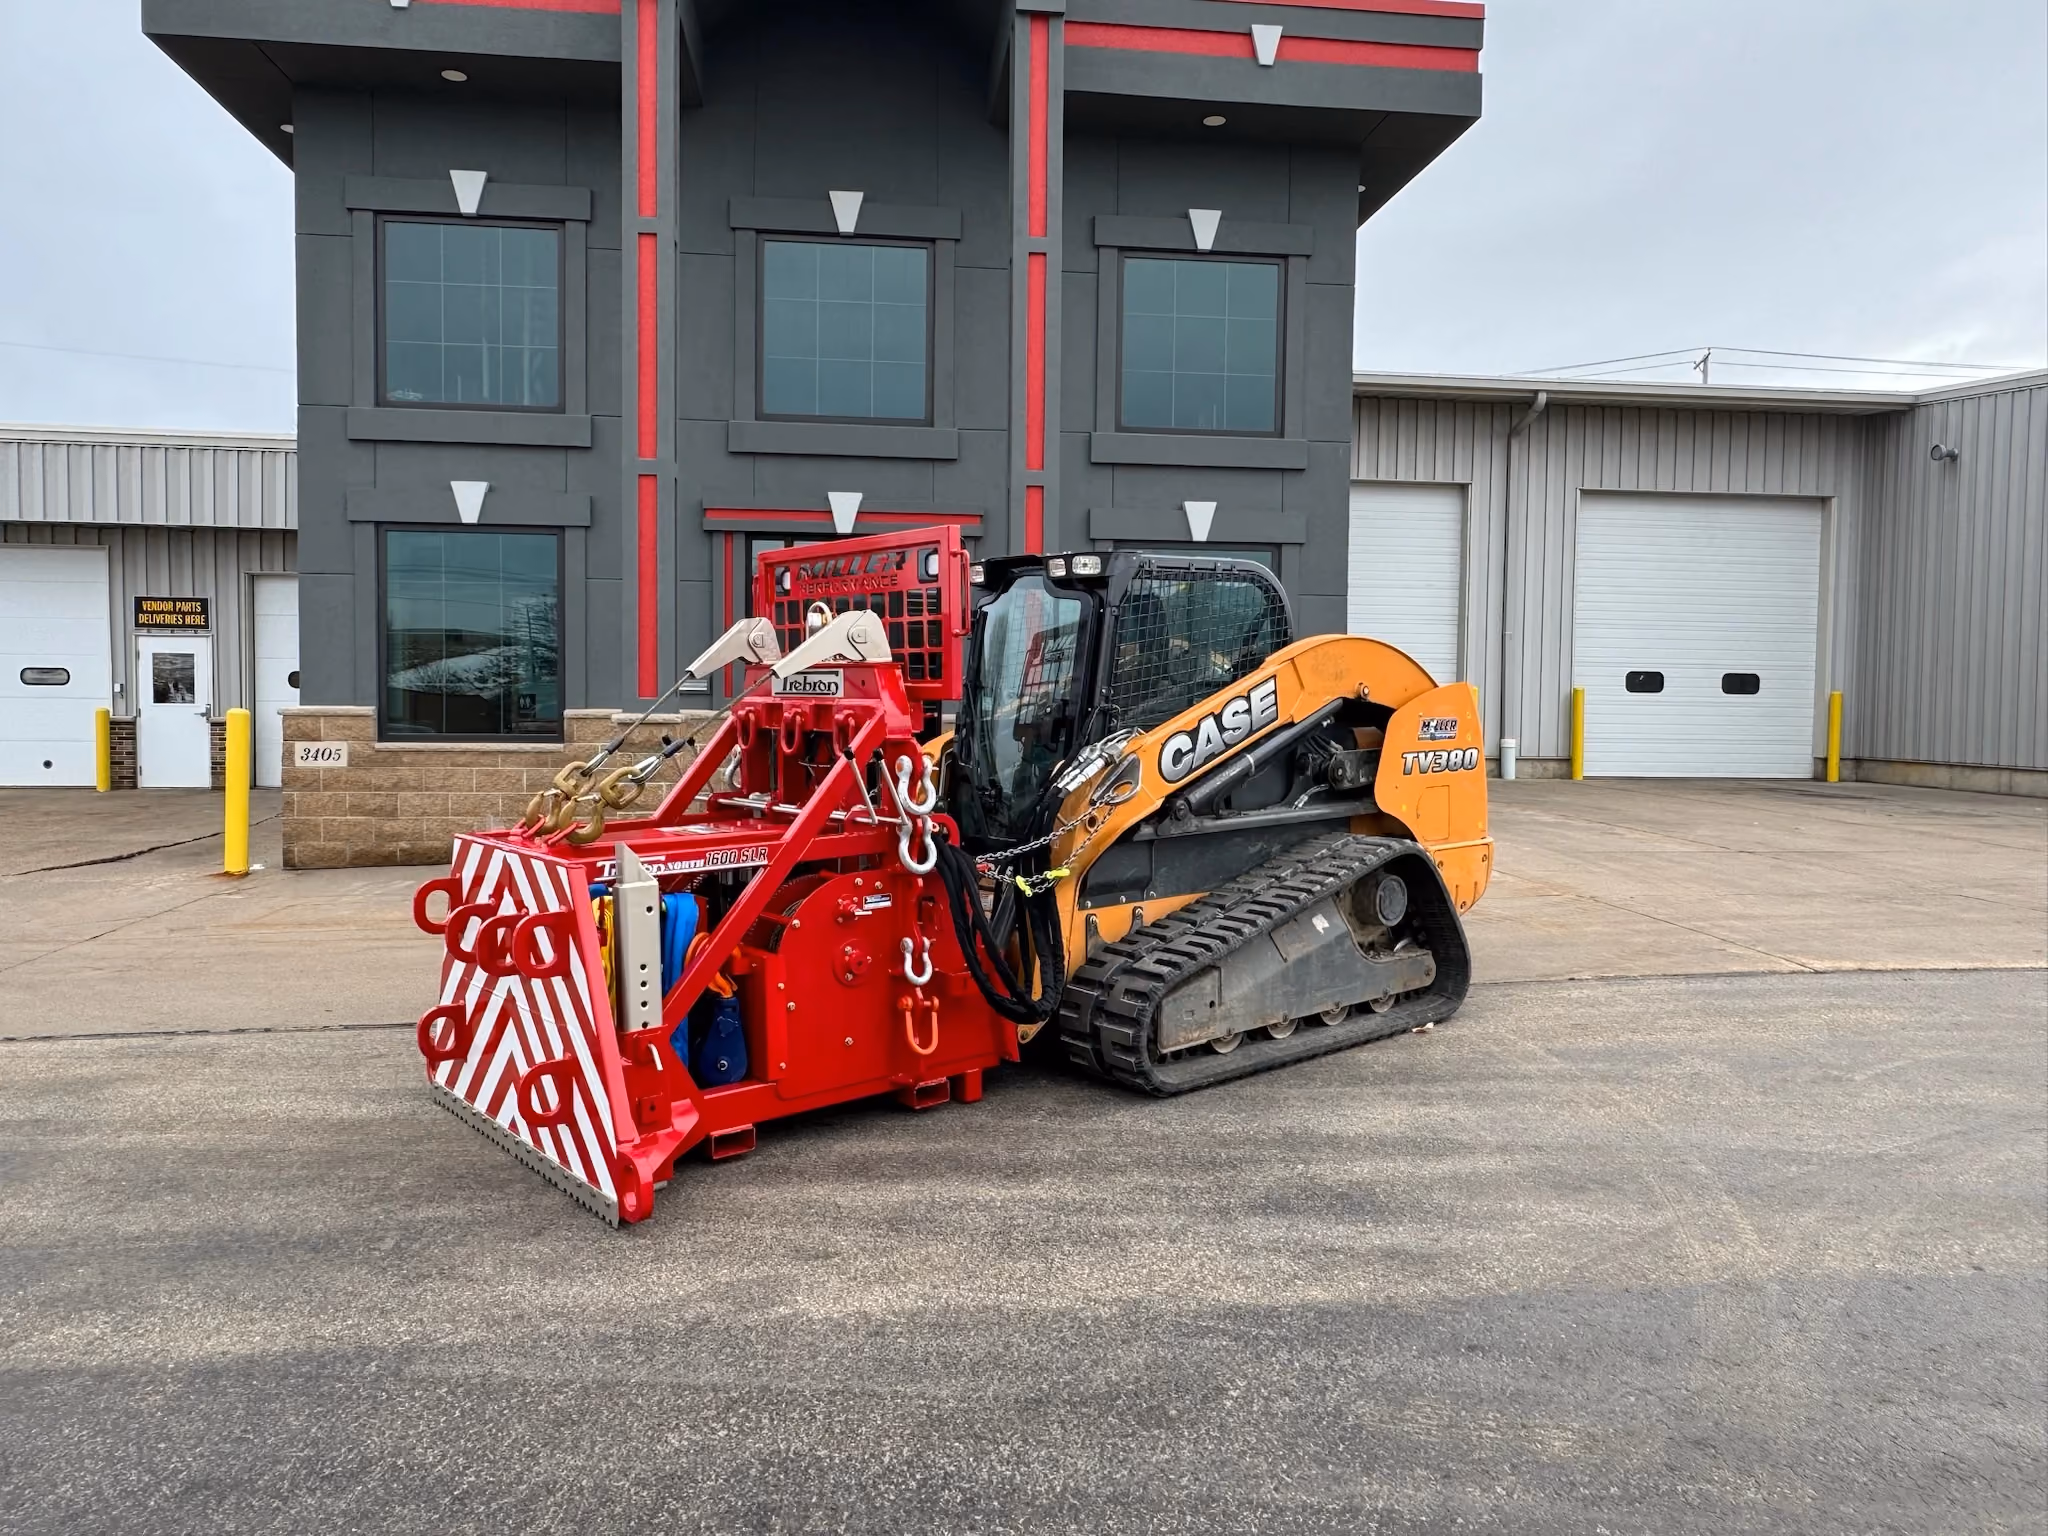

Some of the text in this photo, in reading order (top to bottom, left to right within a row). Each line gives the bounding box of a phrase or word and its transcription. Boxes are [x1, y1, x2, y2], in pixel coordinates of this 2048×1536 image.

[797, 550, 907, 580] MILLER
[142, 601, 202, 612] VENDOR PARTS
[138, 613, 206, 625] DELIVERIES HERE
[1158, 674, 1278, 783] CASE
[300, 747, 342, 761] 3405
[1401, 747, 1479, 776] TV380
[705, 849, 738, 866] 1600
[740, 847, 769, 863] SLR
